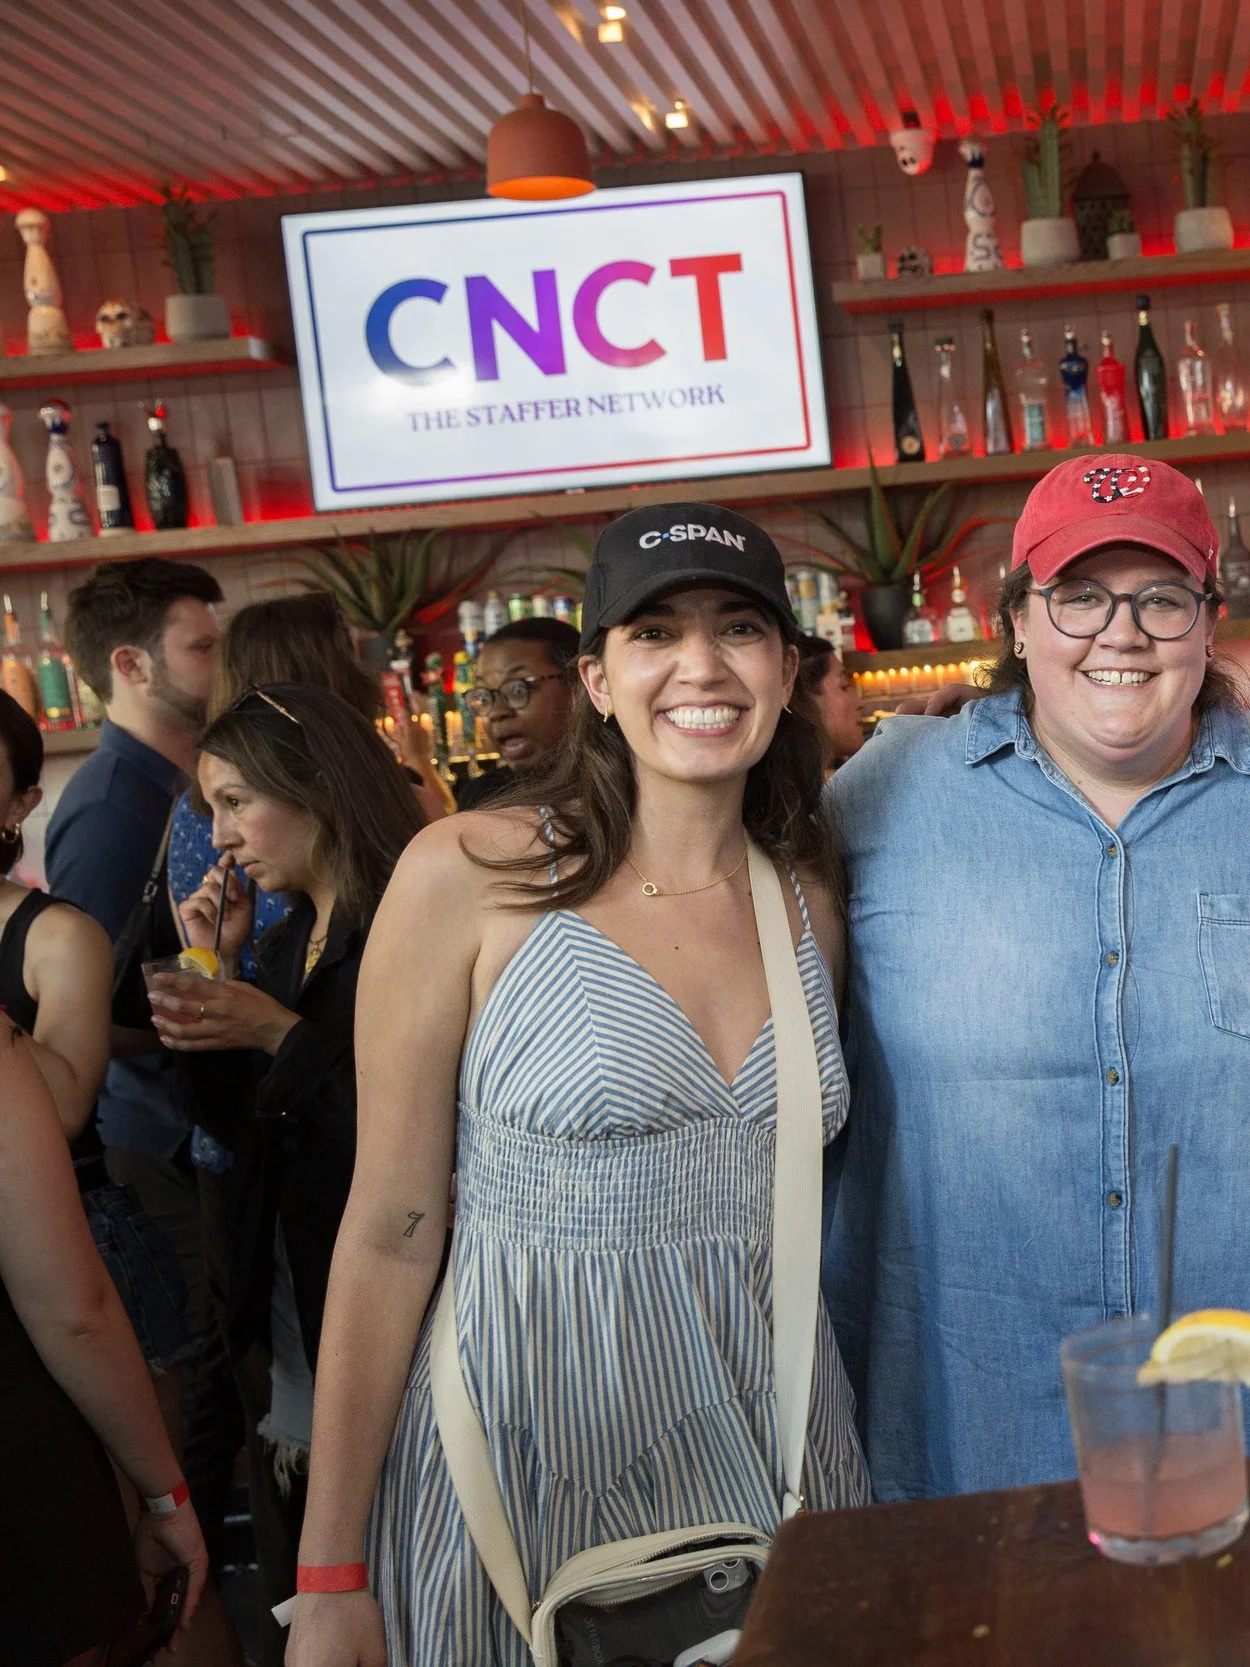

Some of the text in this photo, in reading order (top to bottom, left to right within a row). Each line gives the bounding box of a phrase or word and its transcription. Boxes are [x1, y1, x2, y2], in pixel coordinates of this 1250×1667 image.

[365, 253, 744, 387] CNCT
[407, 384, 725, 432] THE STAFFER NETWORK
[403, 1211, 425, 1238] 7
